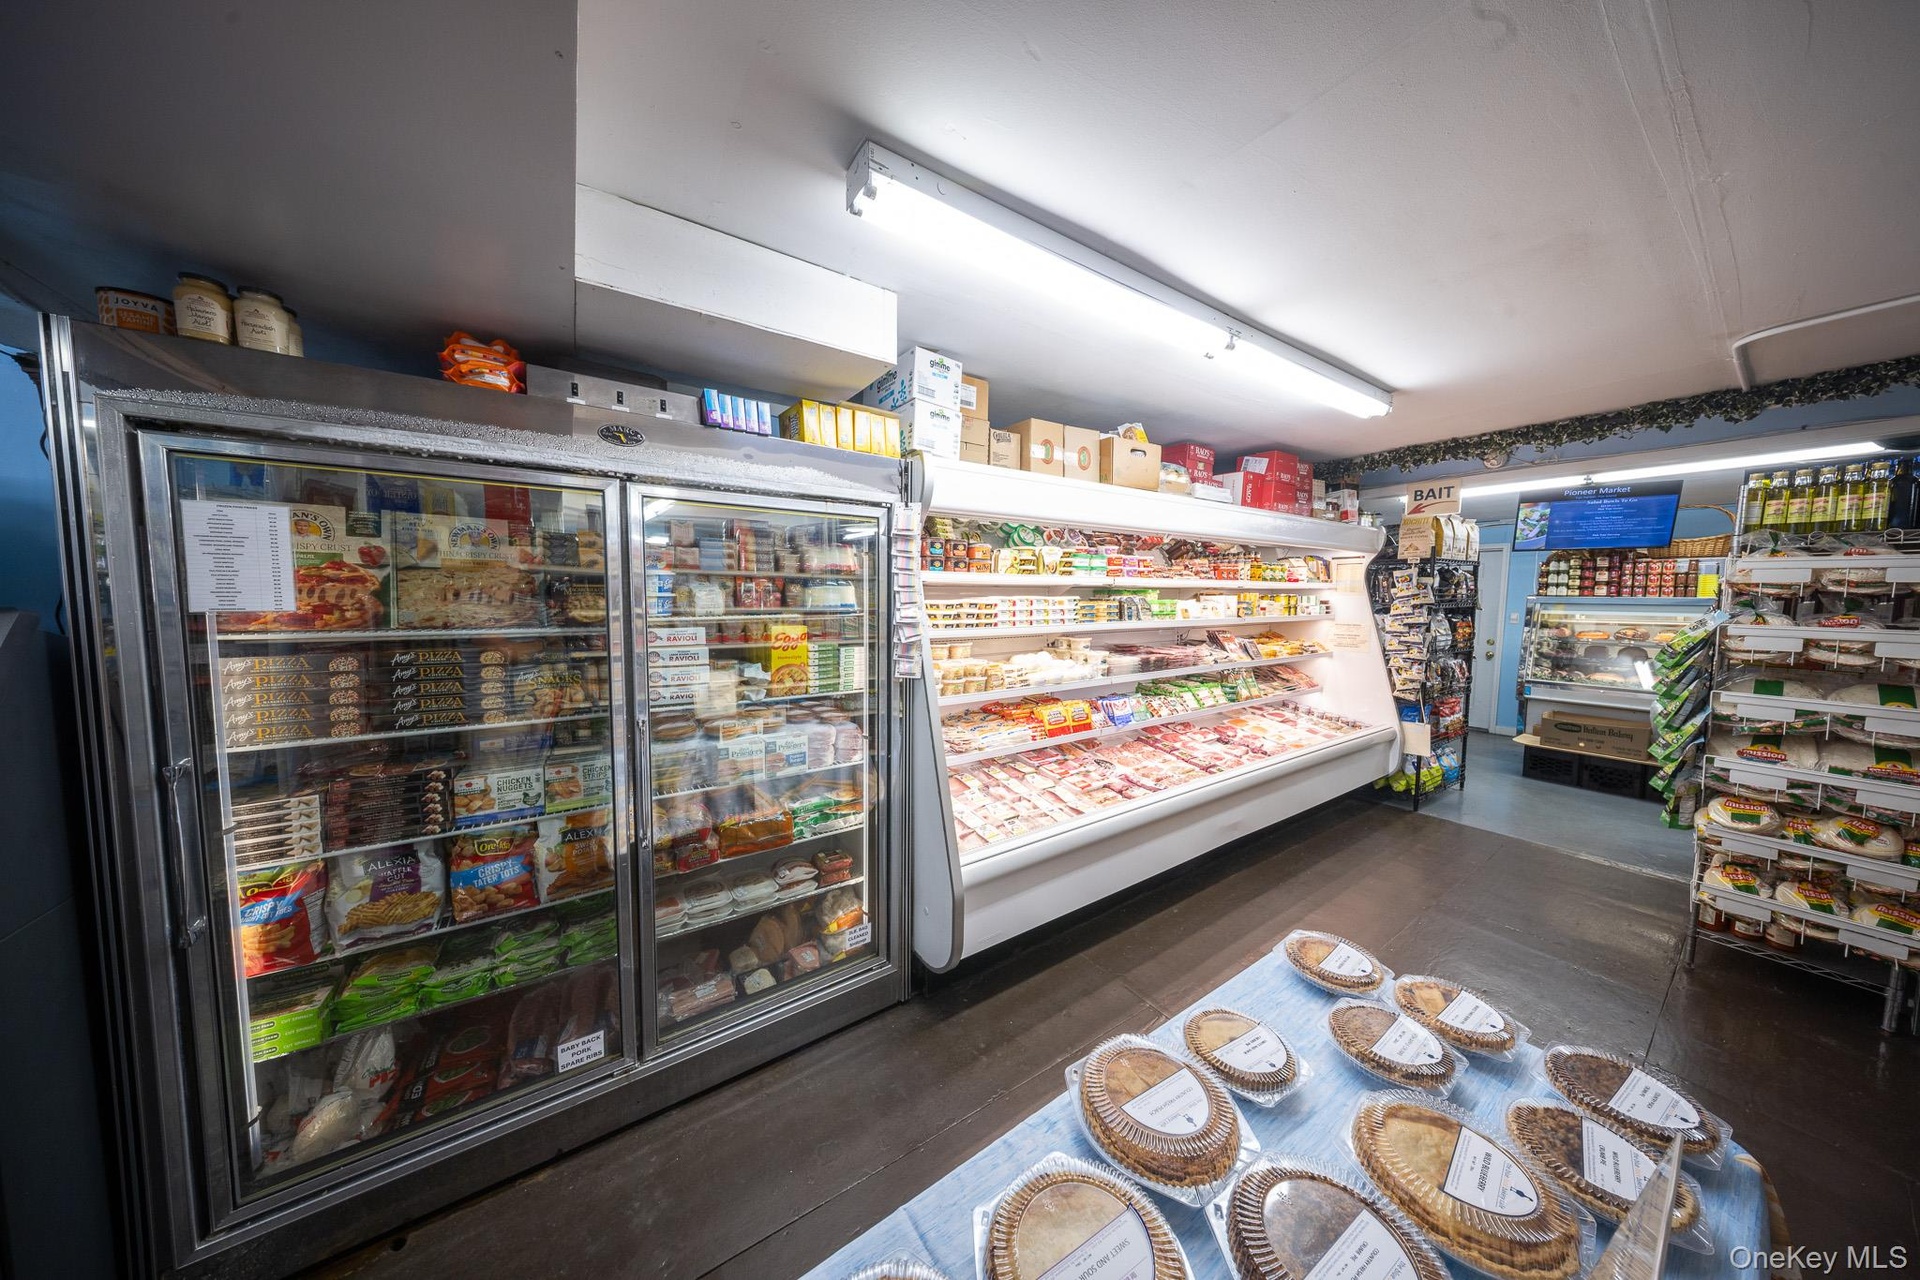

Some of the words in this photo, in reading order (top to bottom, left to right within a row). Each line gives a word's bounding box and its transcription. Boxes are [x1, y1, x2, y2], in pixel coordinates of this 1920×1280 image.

[114, 297, 158, 312] JOYVA
[929, 359, 951, 372] gimme
[929, 410, 951, 422] gimme
[1414, 486, 1455, 502] BAIT
[1564, 488, 1597, 497] Pioneer
[1599, 486, 1631, 495] Market
[319, 520, 332, 540] OWN
[296, 542, 318, 550] ISPY
[320, 543, 352, 551] CRUST
[771, 632, 807, 652] Eggo
[222, 658, 253, 674] Amy's
[253, 656, 313, 670] PIZZA
[390, 651, 417, 666] Amy's
[418, 651, 464, 662] PIZZA
[391, 667, 418, 682] Amy's
[419, 666, 465, 678] PIZZA
[225, 675, 254, 692] Amy's
[254, 674, 314, 688] PIZZA
[392, 683, 418, 698] Amy's
[419, 681, 466, 694] PIZZA
[224, 694, 254, 711] Amy's
[254, 691, 313, 705] PIZZA
[392, 698, 418, 714] Amy's
[419, 697, 466, 710] PIZZA
[225, 711, 255, 727] Amy's
[255, 708, 314, 722] PIZZA
[394, 713, 420, 729] Amy's
[422, 711, 469, 726] PIZZA
[226, 728, 257, 745] Amy's
[256, 724, 316, 739] PIZZA
[1583, 725, 1606, 737] Italian
[1608, 729, 1633, 742] Bakery
[582, 764, 612, 774] CHICKEN
[496, 776, 531, 787] CHICKEN
[496, 781, 533, 793] NUGGETS
[368, 855, 416, 872] ALEXIA
[478, 859, 512, 878] CRISPY
[472, 874, 498, 888] TATER
[500, 866, 520, 879] TOTS
[245, 900, 283, 918] CRISPY
[560, 1042, 580, 1054] BABY
[581, 1034, 601, 1046] BACK
[571, 1046, 592, 1057] PORK
[560, 1056, 585, 1070] SPARE
[586, 1050, 602, 1061] RIBS
[1482, 1151, 1493, 1166] WILD
[1476, 1163, 1491, 1193] BLUEBERRY
[1109, 1237, 1131, 1258] SWEET
[1096, 1253, 1111, 1269] AND
[1363, 1247, 1380, 1268] COUNTRY
[1078, 1264, 1098, 1280] SOUR
